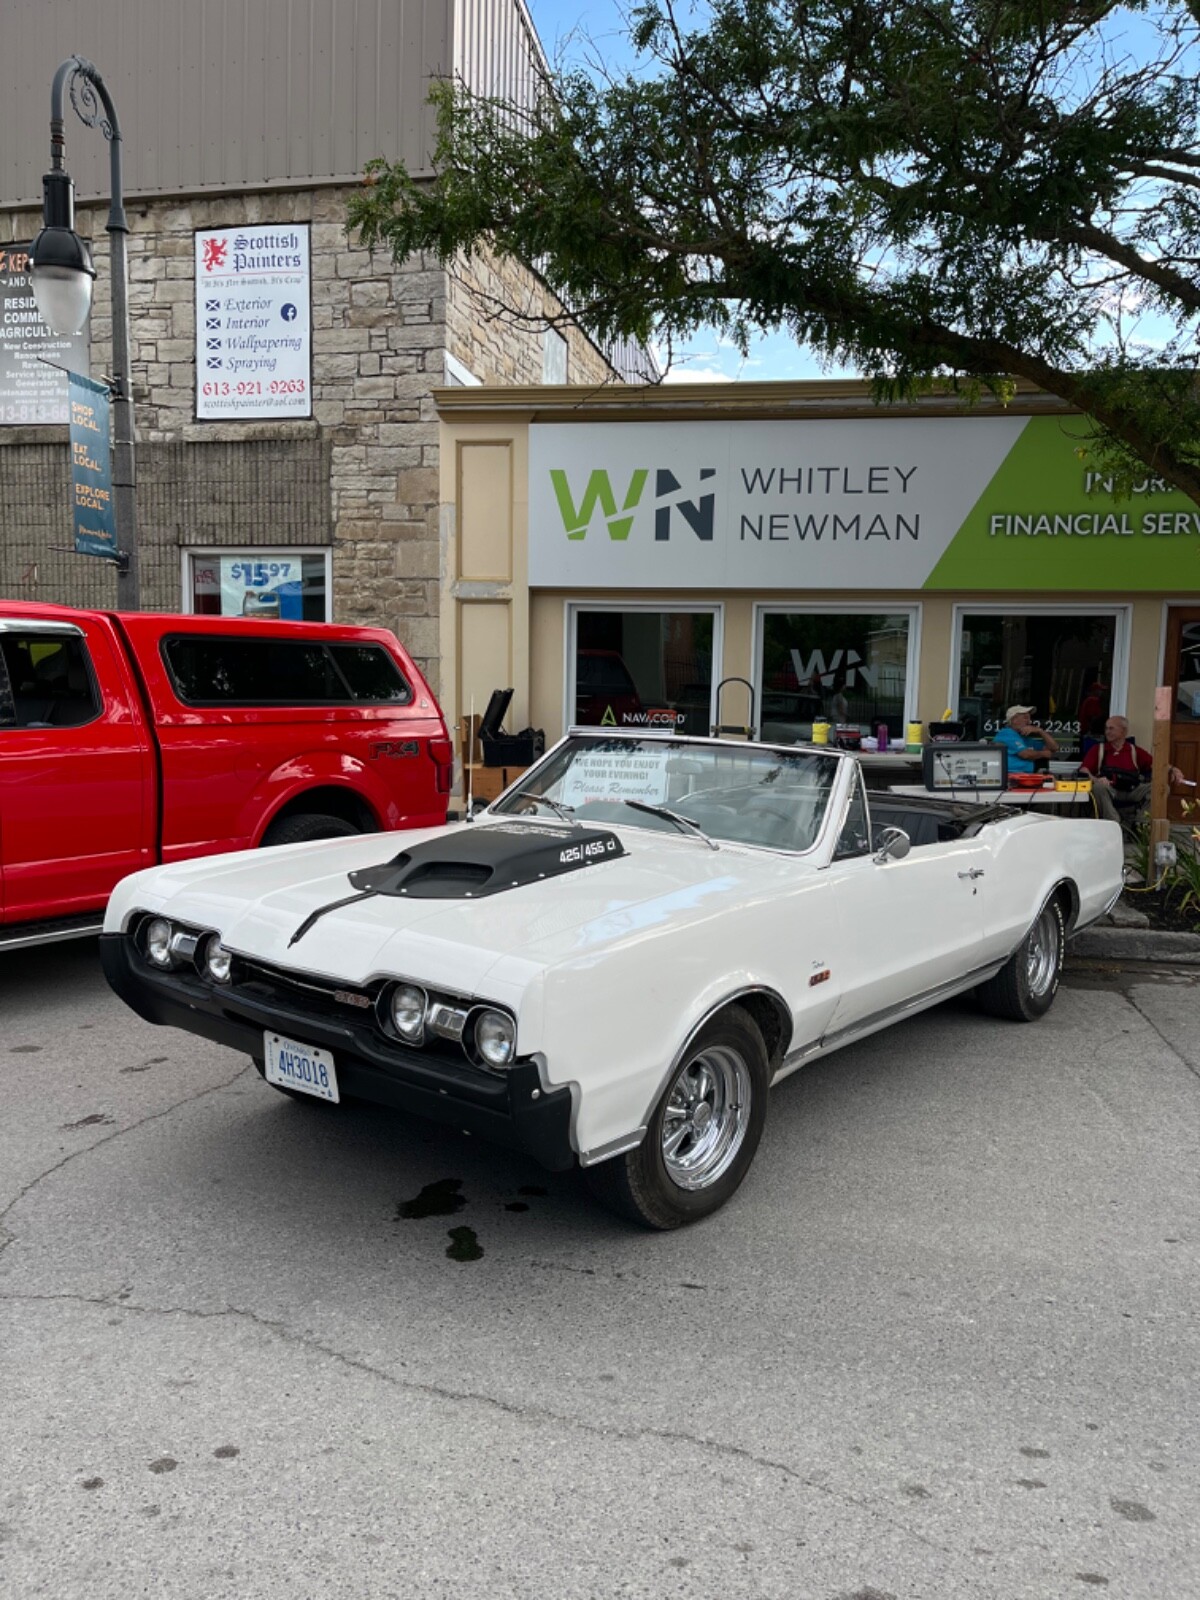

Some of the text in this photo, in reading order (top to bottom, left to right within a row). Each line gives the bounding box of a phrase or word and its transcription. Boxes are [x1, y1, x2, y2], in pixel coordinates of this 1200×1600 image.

[234, 233, 298, 251] Scottish
[233, 253, 301, 272] Painters
[8, 276, 26, 288] AND
[224, 296, 273, 312] Exterior
[226, 316, 271, 330] Interior
[4, 341, 72, 350] New Construction
[224, 335, 303, 353] Wallpapering
[14, 351, 61, 360] Renovations
[226, 355, 277, 373] Spraying
[6, 370, 35, 379] Service
[15, 379, 59, 388] Generators
[40, 388, 54, 396] and
[71, 400, 95, 418] SHOP
[73, 442, 88, 456] EAT
[75, 483, 110, 501] EXPLORE
[549, 466, 918, 541] WN WHITLEY
[740, 514, 920, 541] NEWMAN
[990, 513, 1134, 536] FINANCIAL
[368, 740, 419, 760] FX4
[590, 758, 613, 768] HOPE
[615, 759, 633, 769] YOU
[634, 759, 660, 770] ENJOY
[583, 769, 649, 780] YOUR EVENING!
[572, 780, 660, 796] Please Remember
